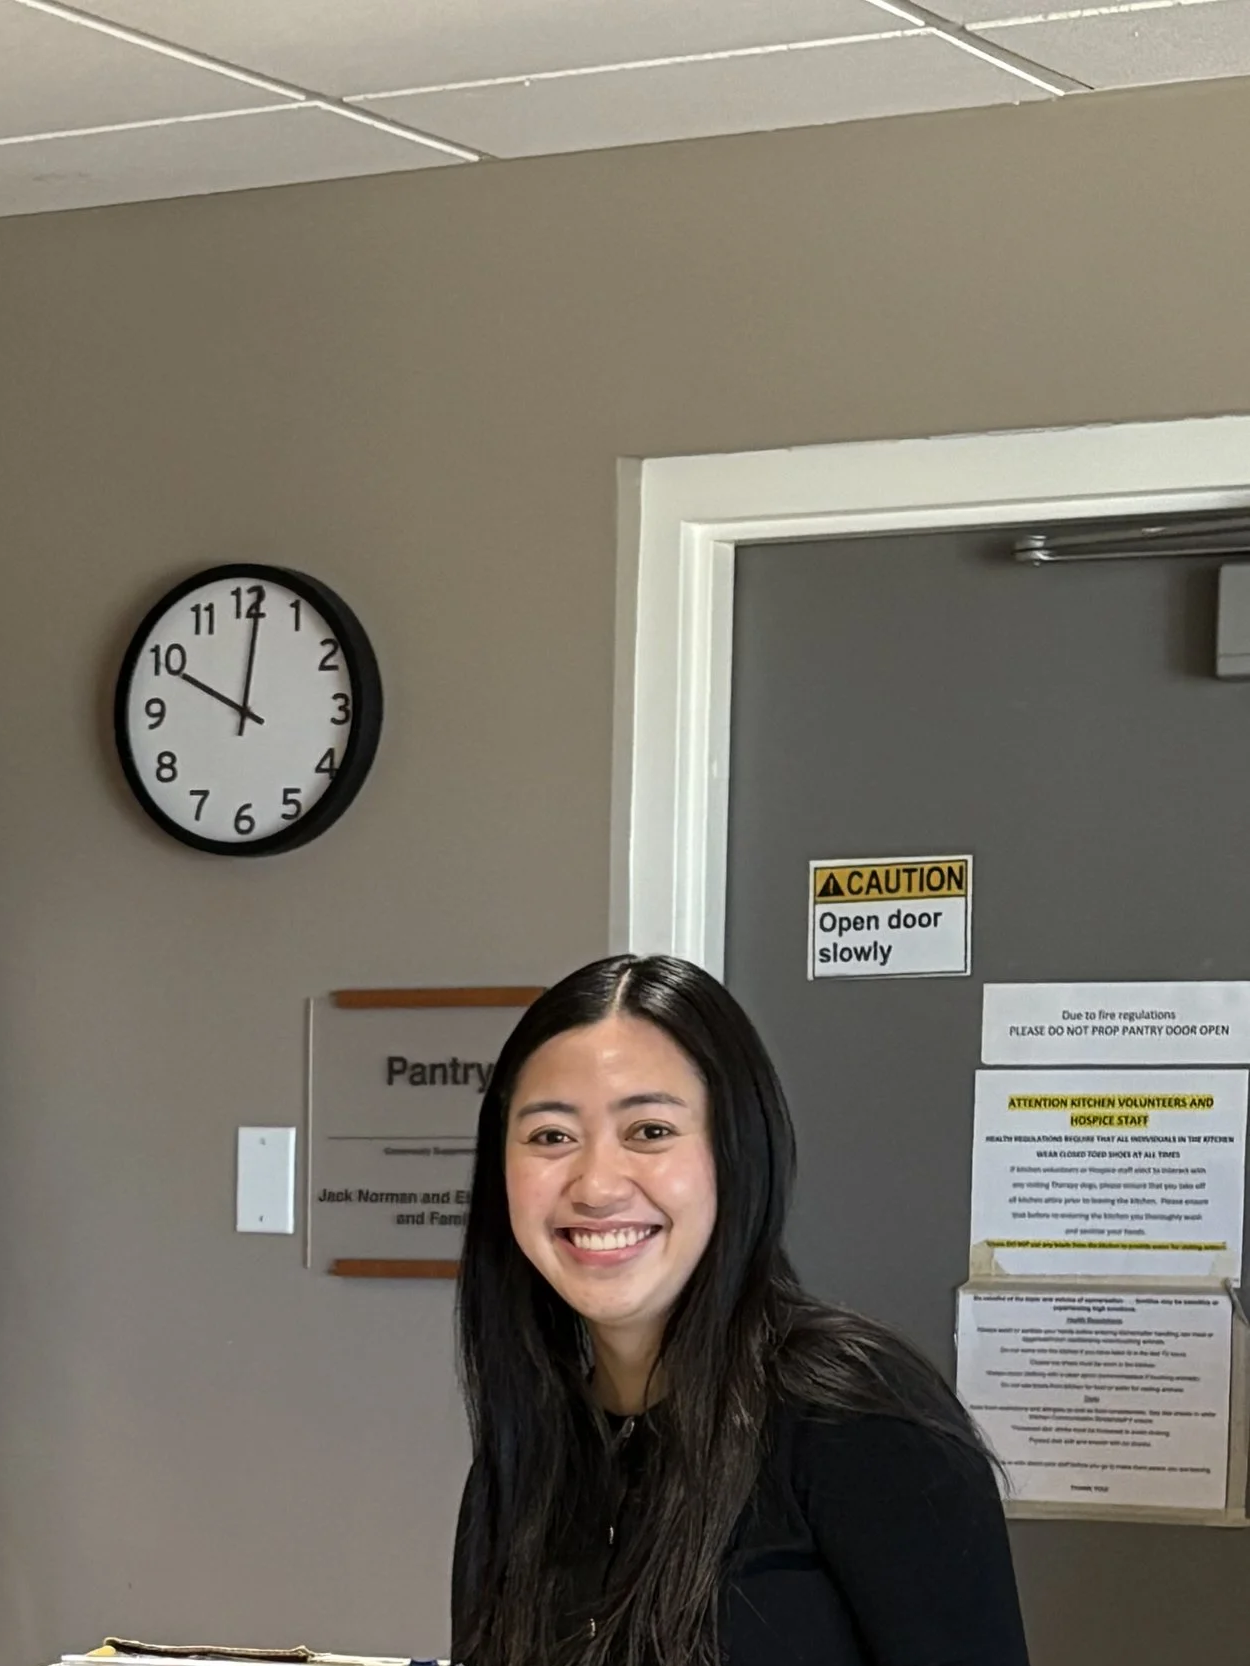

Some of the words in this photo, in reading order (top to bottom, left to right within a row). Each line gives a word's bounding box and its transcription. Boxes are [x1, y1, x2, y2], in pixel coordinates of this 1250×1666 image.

[190, 603, 214, 635] 11
[290, 600, 302, 631] 1
[150, 643, 186, 676] 10
[318, 638, 339, 671] 2
[145, 698, 166, 730] 9
[330, 693, 350, 725] 3
[155, 751, 177, 782] 8
[315, 748, 340, 780] 4
[189, 789, 210, 821] 7
[234, 803, 255, 835] 6
[281, 788, 302, 820] 5
[847, 866, 964, 895] CAUTION
[819, 911, 880, 937] Open
[888, 909, 943, 930] door
[819, 941, 892, 966] slowly
[1009, 1027, 1045, 1037] PLEASE
[1049, 1026, 1064, 1036] DO
[1067, 1026, 1089, 1036] NOT
[1091, 1026, 1120, 1036] PROP
[1122, 1025, 1163, 1036] PANTRY
[1166, 1025, 1197, 1035] DOOR
[1200, 1024, 1230, 1035] OPEN
[1062, 1010, 1083, 1020] Due
[1085, 1010, 1097, 1020] to
[1098, 1009, 1116, 1020] fire
[1118, 1009, 1176, 1021] regulations
[386, 1056, 495, 1093] Pantry
[1008, 1097, 1067, 1109] ATTENTION
[1071, 1097, 1115, 1108] KITCHEN
[1118, 1097, 1187, 1108] VOLUNTEERS
[1190, 1096, 1214, 1108] AND
[1070, 1115, 1113, 1126] HOSPICE
[1117, 1115, 1149, 1126] STAFF
[318, 1189, 352, 1203] Jack
[358, 1190, 417, 1204] Norman
[420, 1191, 450, 1204] and
[396, 1212, 425, 1225] and
